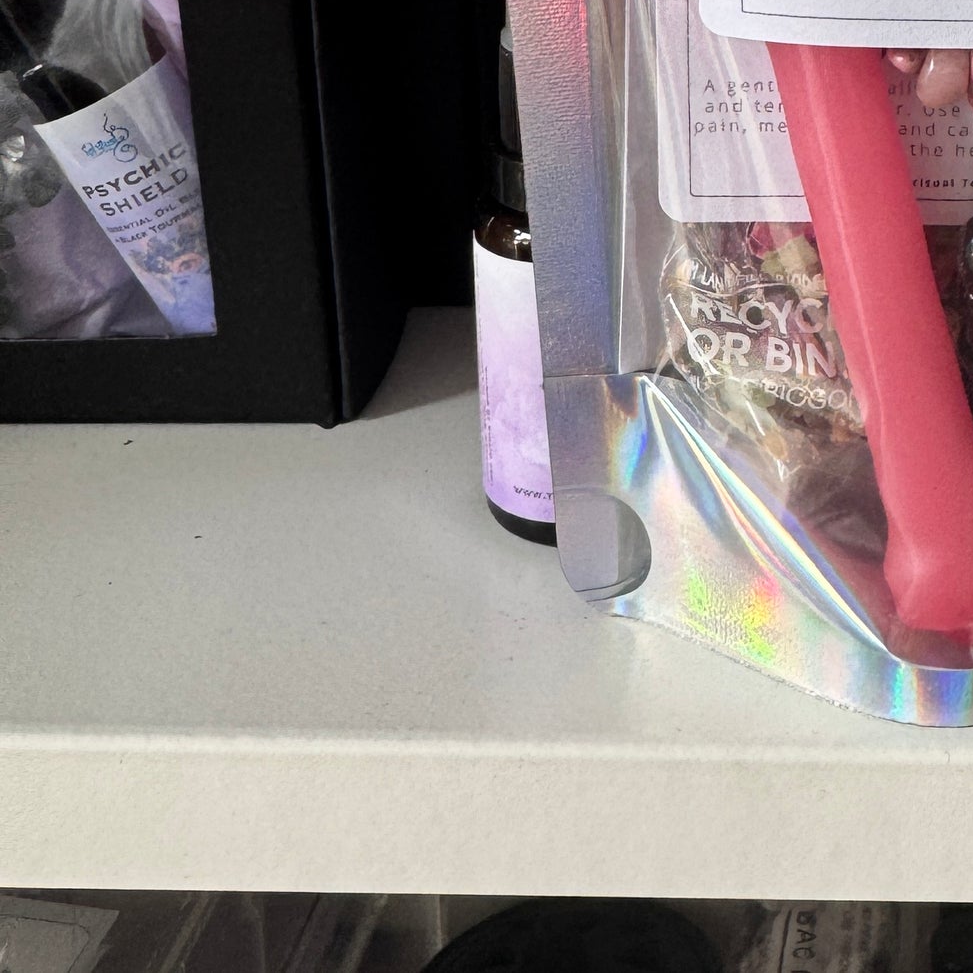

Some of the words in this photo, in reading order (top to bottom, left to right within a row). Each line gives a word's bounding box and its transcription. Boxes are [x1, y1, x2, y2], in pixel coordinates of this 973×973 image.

[703, 79, 716, 95] A
[705, 102, 743, 113] and
[694, 121, 747, 136] pain,
[898, 122, 935, 137] and
[910, 141, 944, 157] the
[81, 142, 187, 200] PSYCHIC
[99, 167, 189, 217] SHIELD
[690, 291, 824, 336] RECYC
[688, 327, 752, 368] OR
